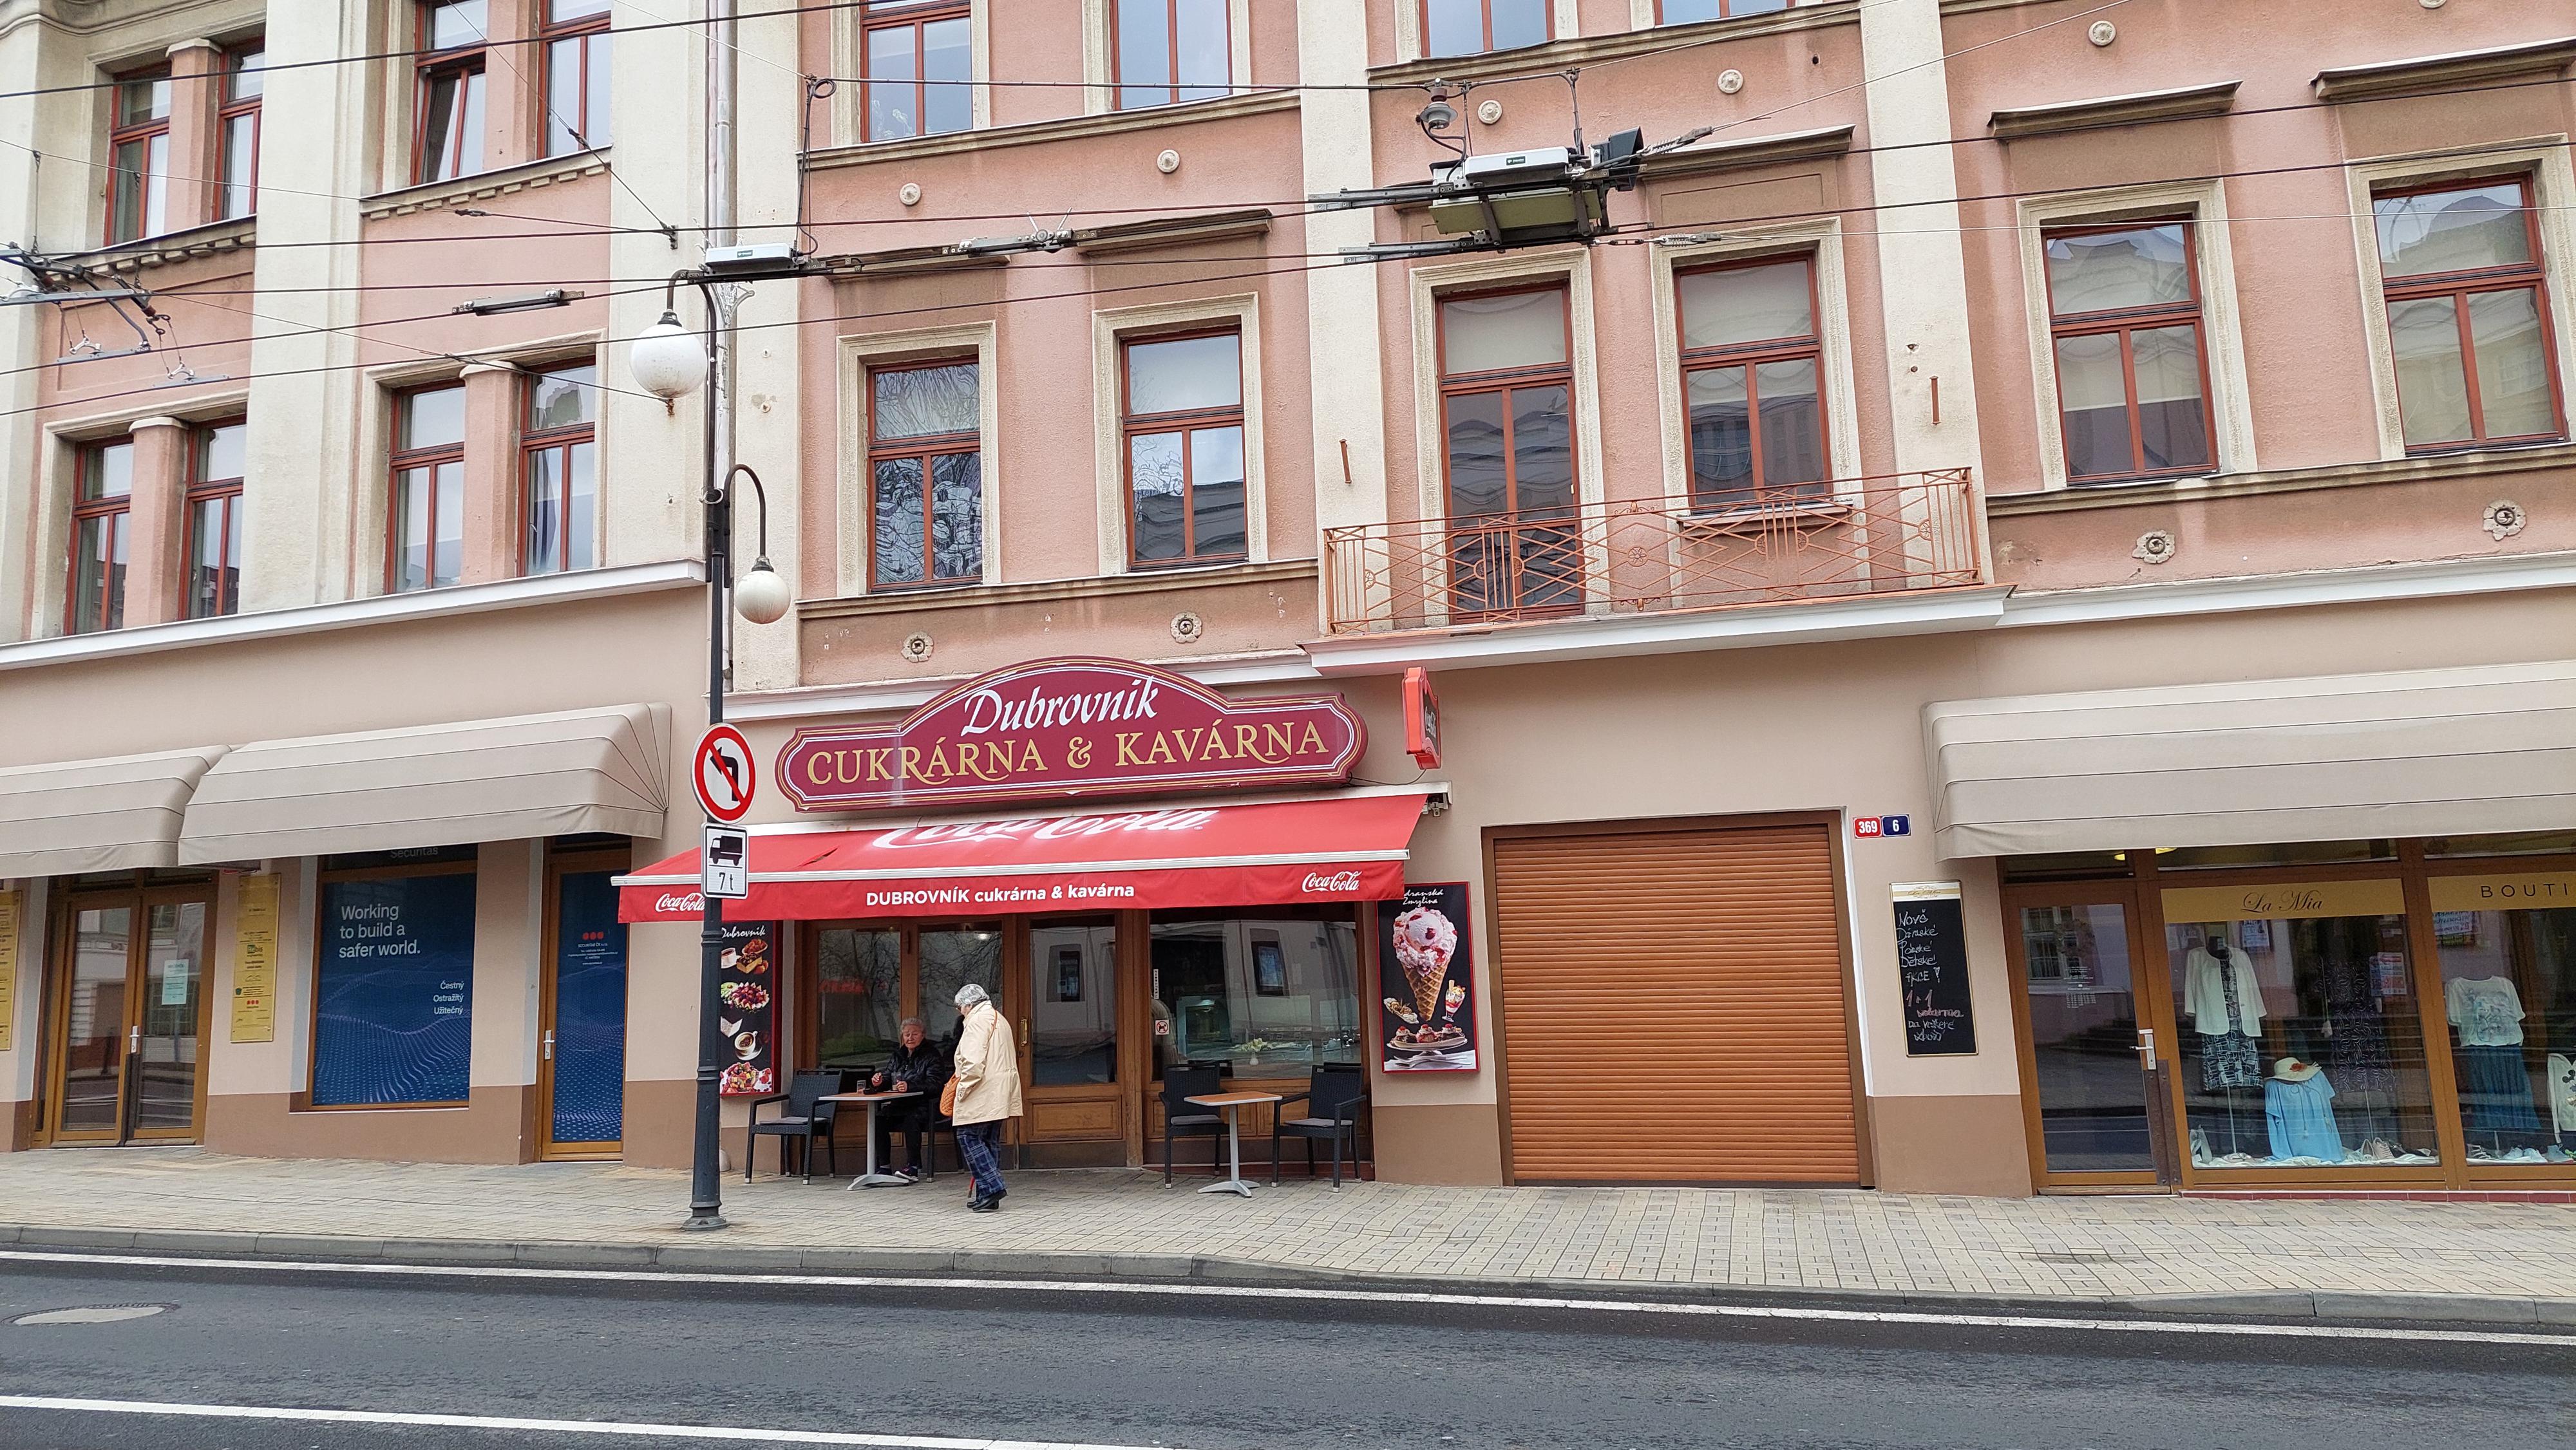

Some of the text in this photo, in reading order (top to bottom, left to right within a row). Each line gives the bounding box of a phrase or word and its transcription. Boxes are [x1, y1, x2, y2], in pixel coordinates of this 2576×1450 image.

[961, 675, 1159, 737] Dubrovnik
[807, 719, 1329, 785] CUKRÁRNA & KAVÁRNA
[1858, 820, 1878, 834] 369
[1892, 819, 1900, 832] 6
[719, 872, 734, 890] 7 t
[1302, 871, 1363, 893] Coca-Cola
[866, 883, 1135, 906] DUBROVNÍK cukrárna & kavárna
[1404, 889, 1444, 897] dranská
[2481, 883, 2568, 898] BOUTI
[2240, 890, 2324, 913] La Mia
[341, 903, 399, 921] Working
[339, 922, 406, 939] to build a
[339, 939, 421, 958] safer world.
[440, 980, 464, 990] Čestný
[433, 993, 464, 1003] Ostražitý
[433, 1005, 464, 1015] Užitečný
